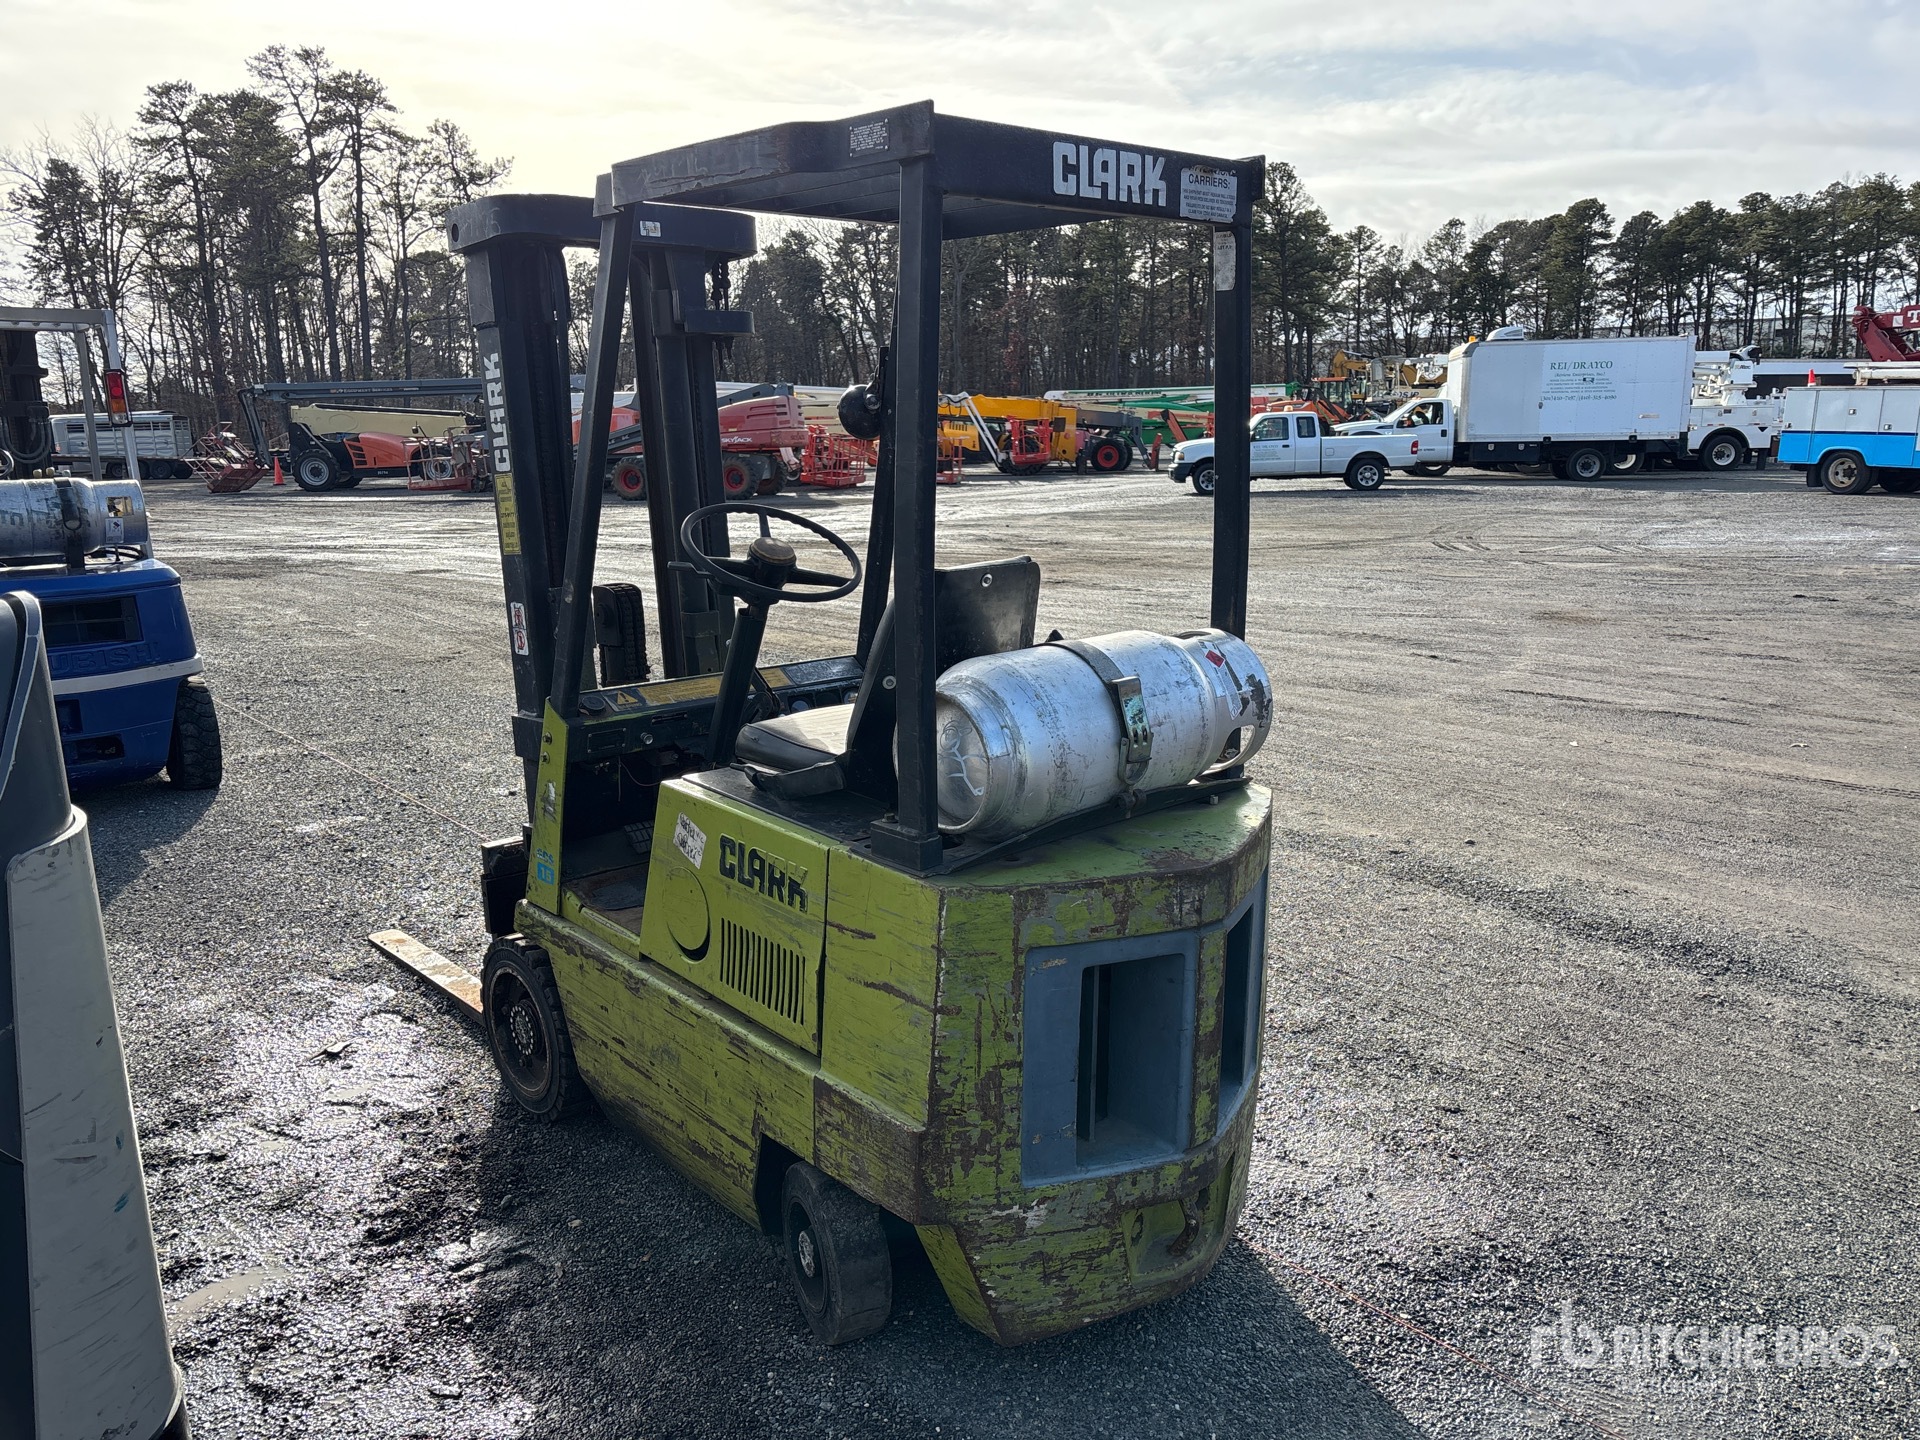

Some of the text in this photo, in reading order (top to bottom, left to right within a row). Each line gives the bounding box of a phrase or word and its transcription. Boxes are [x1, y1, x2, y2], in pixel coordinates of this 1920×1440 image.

[1053, 141, 1167, 207] CLARK
[1188, 173, 1231, 190] CARRIERS:
[1550, 360, 1613, 371] REI/DRAYCO
[483, 352, 511, 472] CLARK
[721, 435, 753, 443] SKYJACK
[719, 832, 809, 915] CLARK
